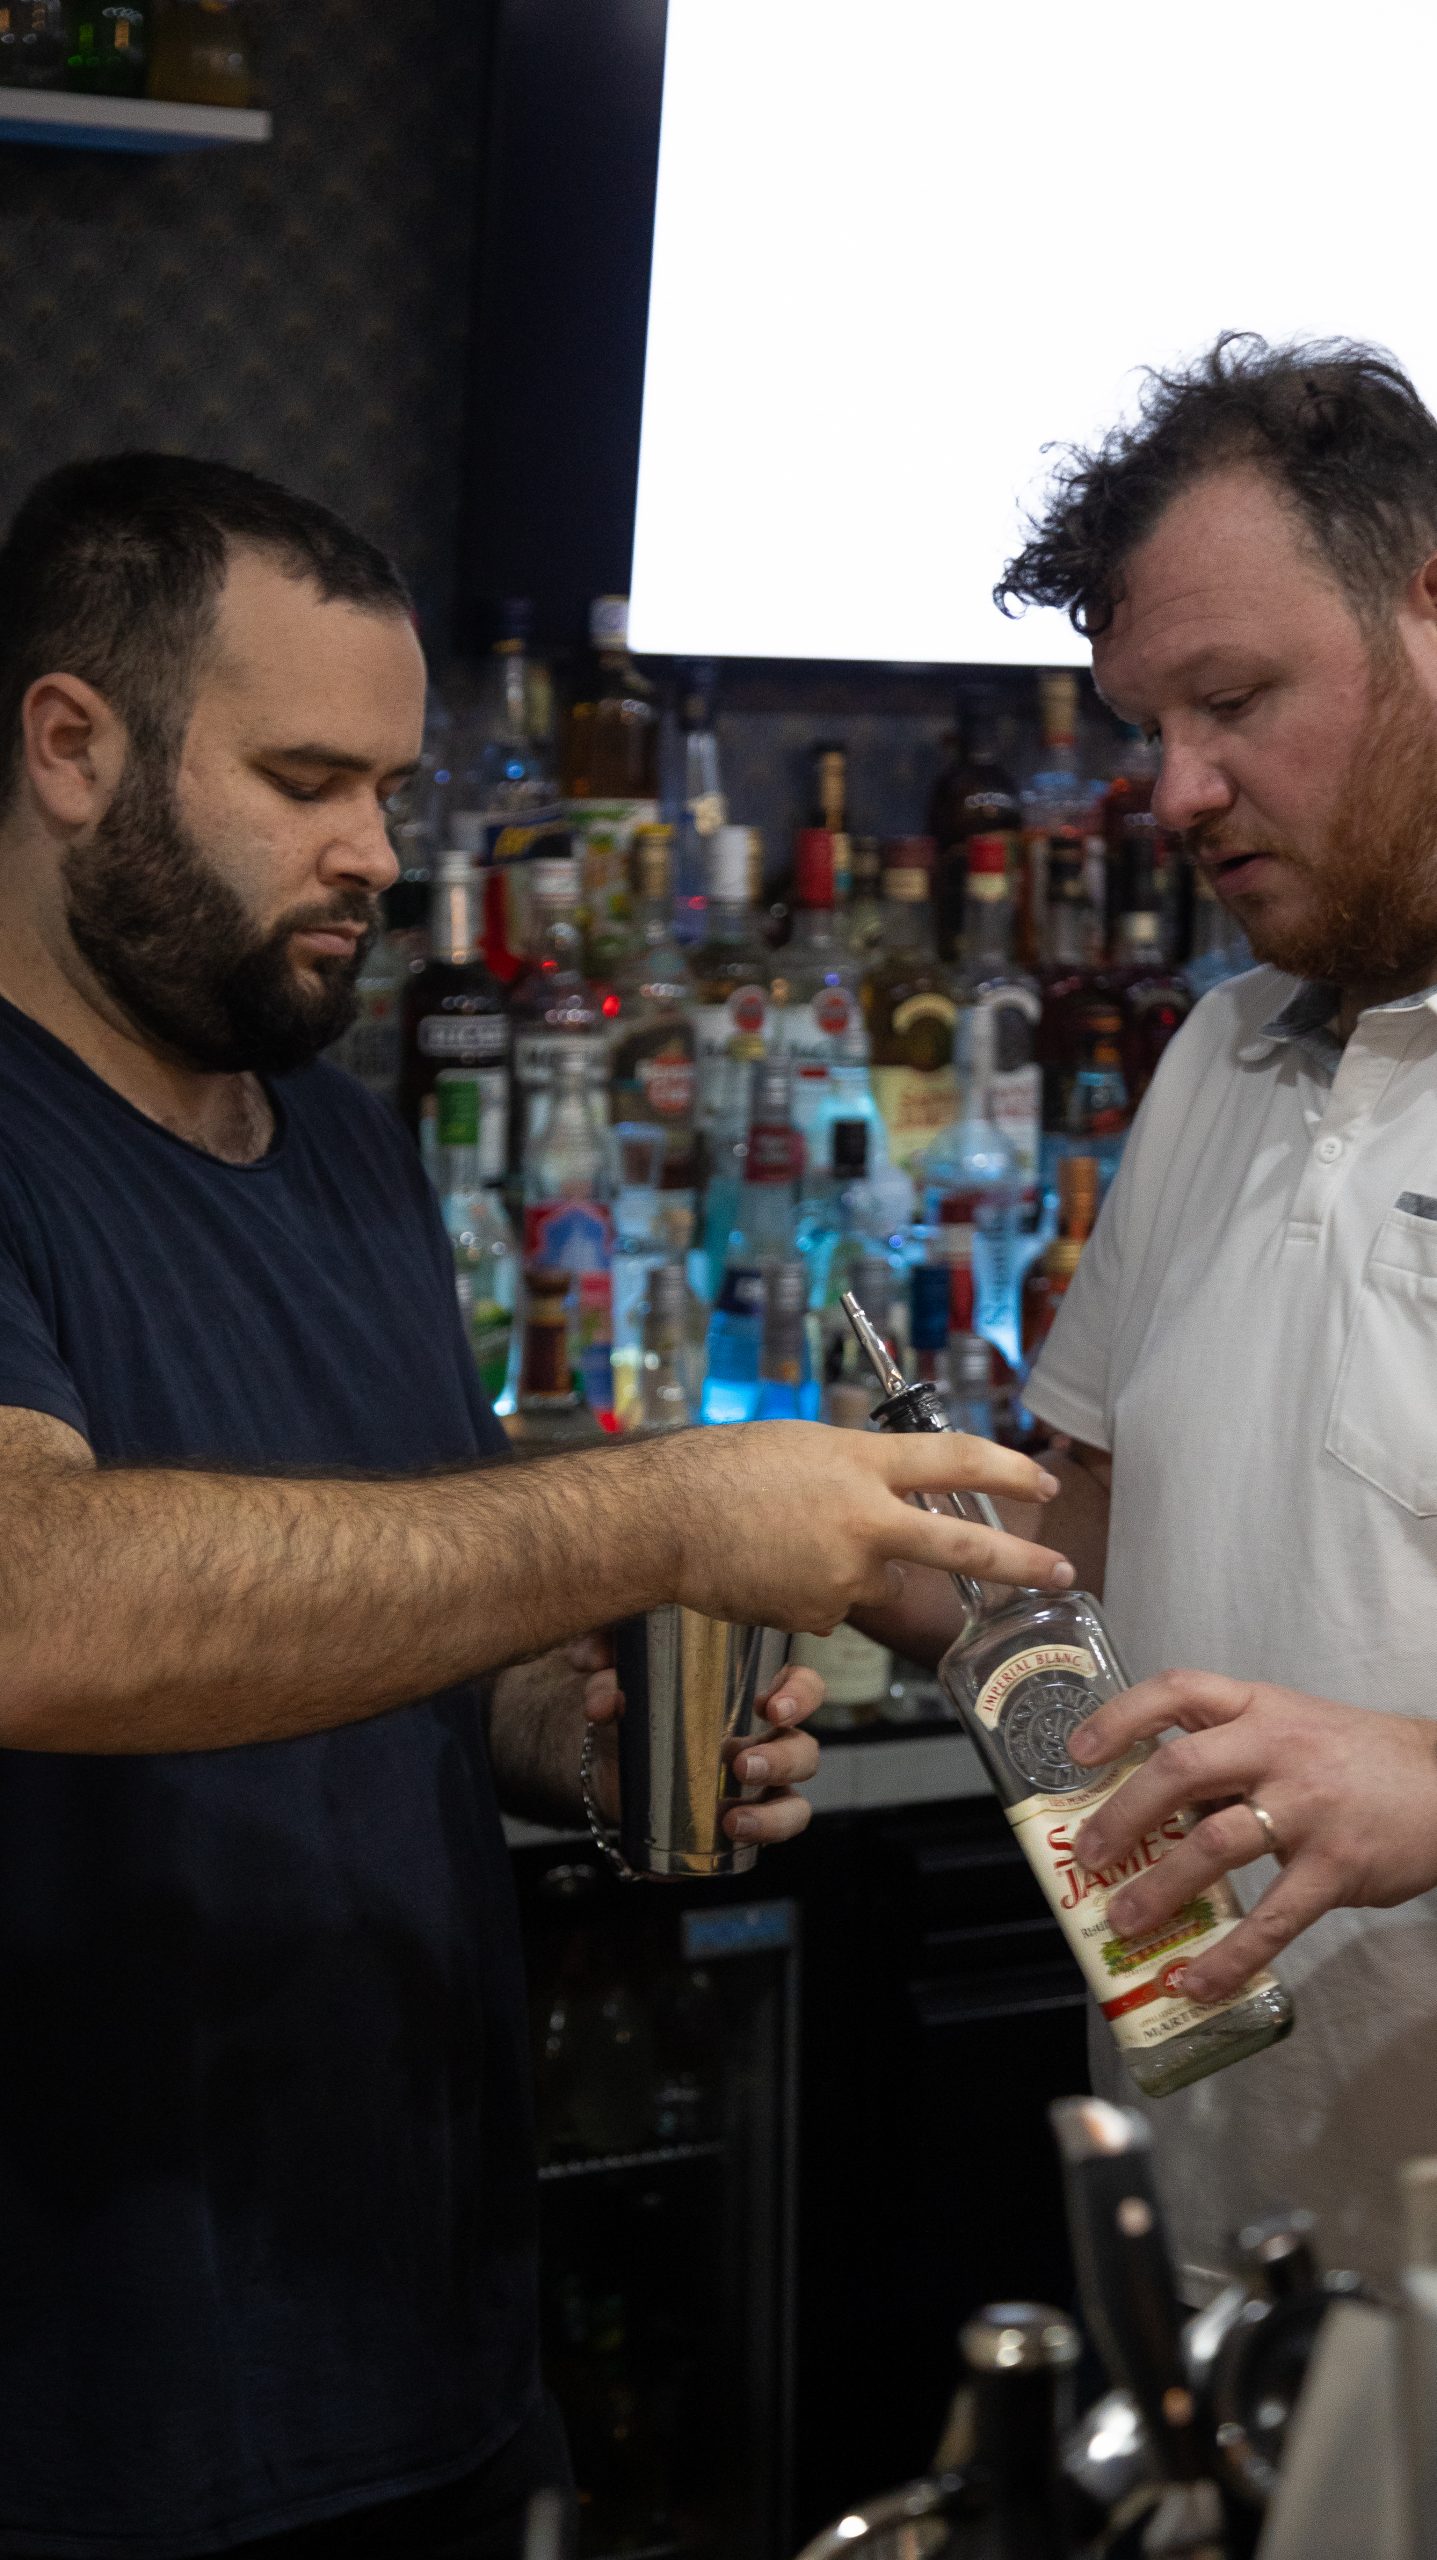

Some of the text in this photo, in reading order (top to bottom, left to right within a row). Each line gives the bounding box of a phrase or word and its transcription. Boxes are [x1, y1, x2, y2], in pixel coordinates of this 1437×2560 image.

[982, 1651, 1082, 1713] IMPERIAL BLANC
[1055, 1815, 1186, 1910] JAMES
